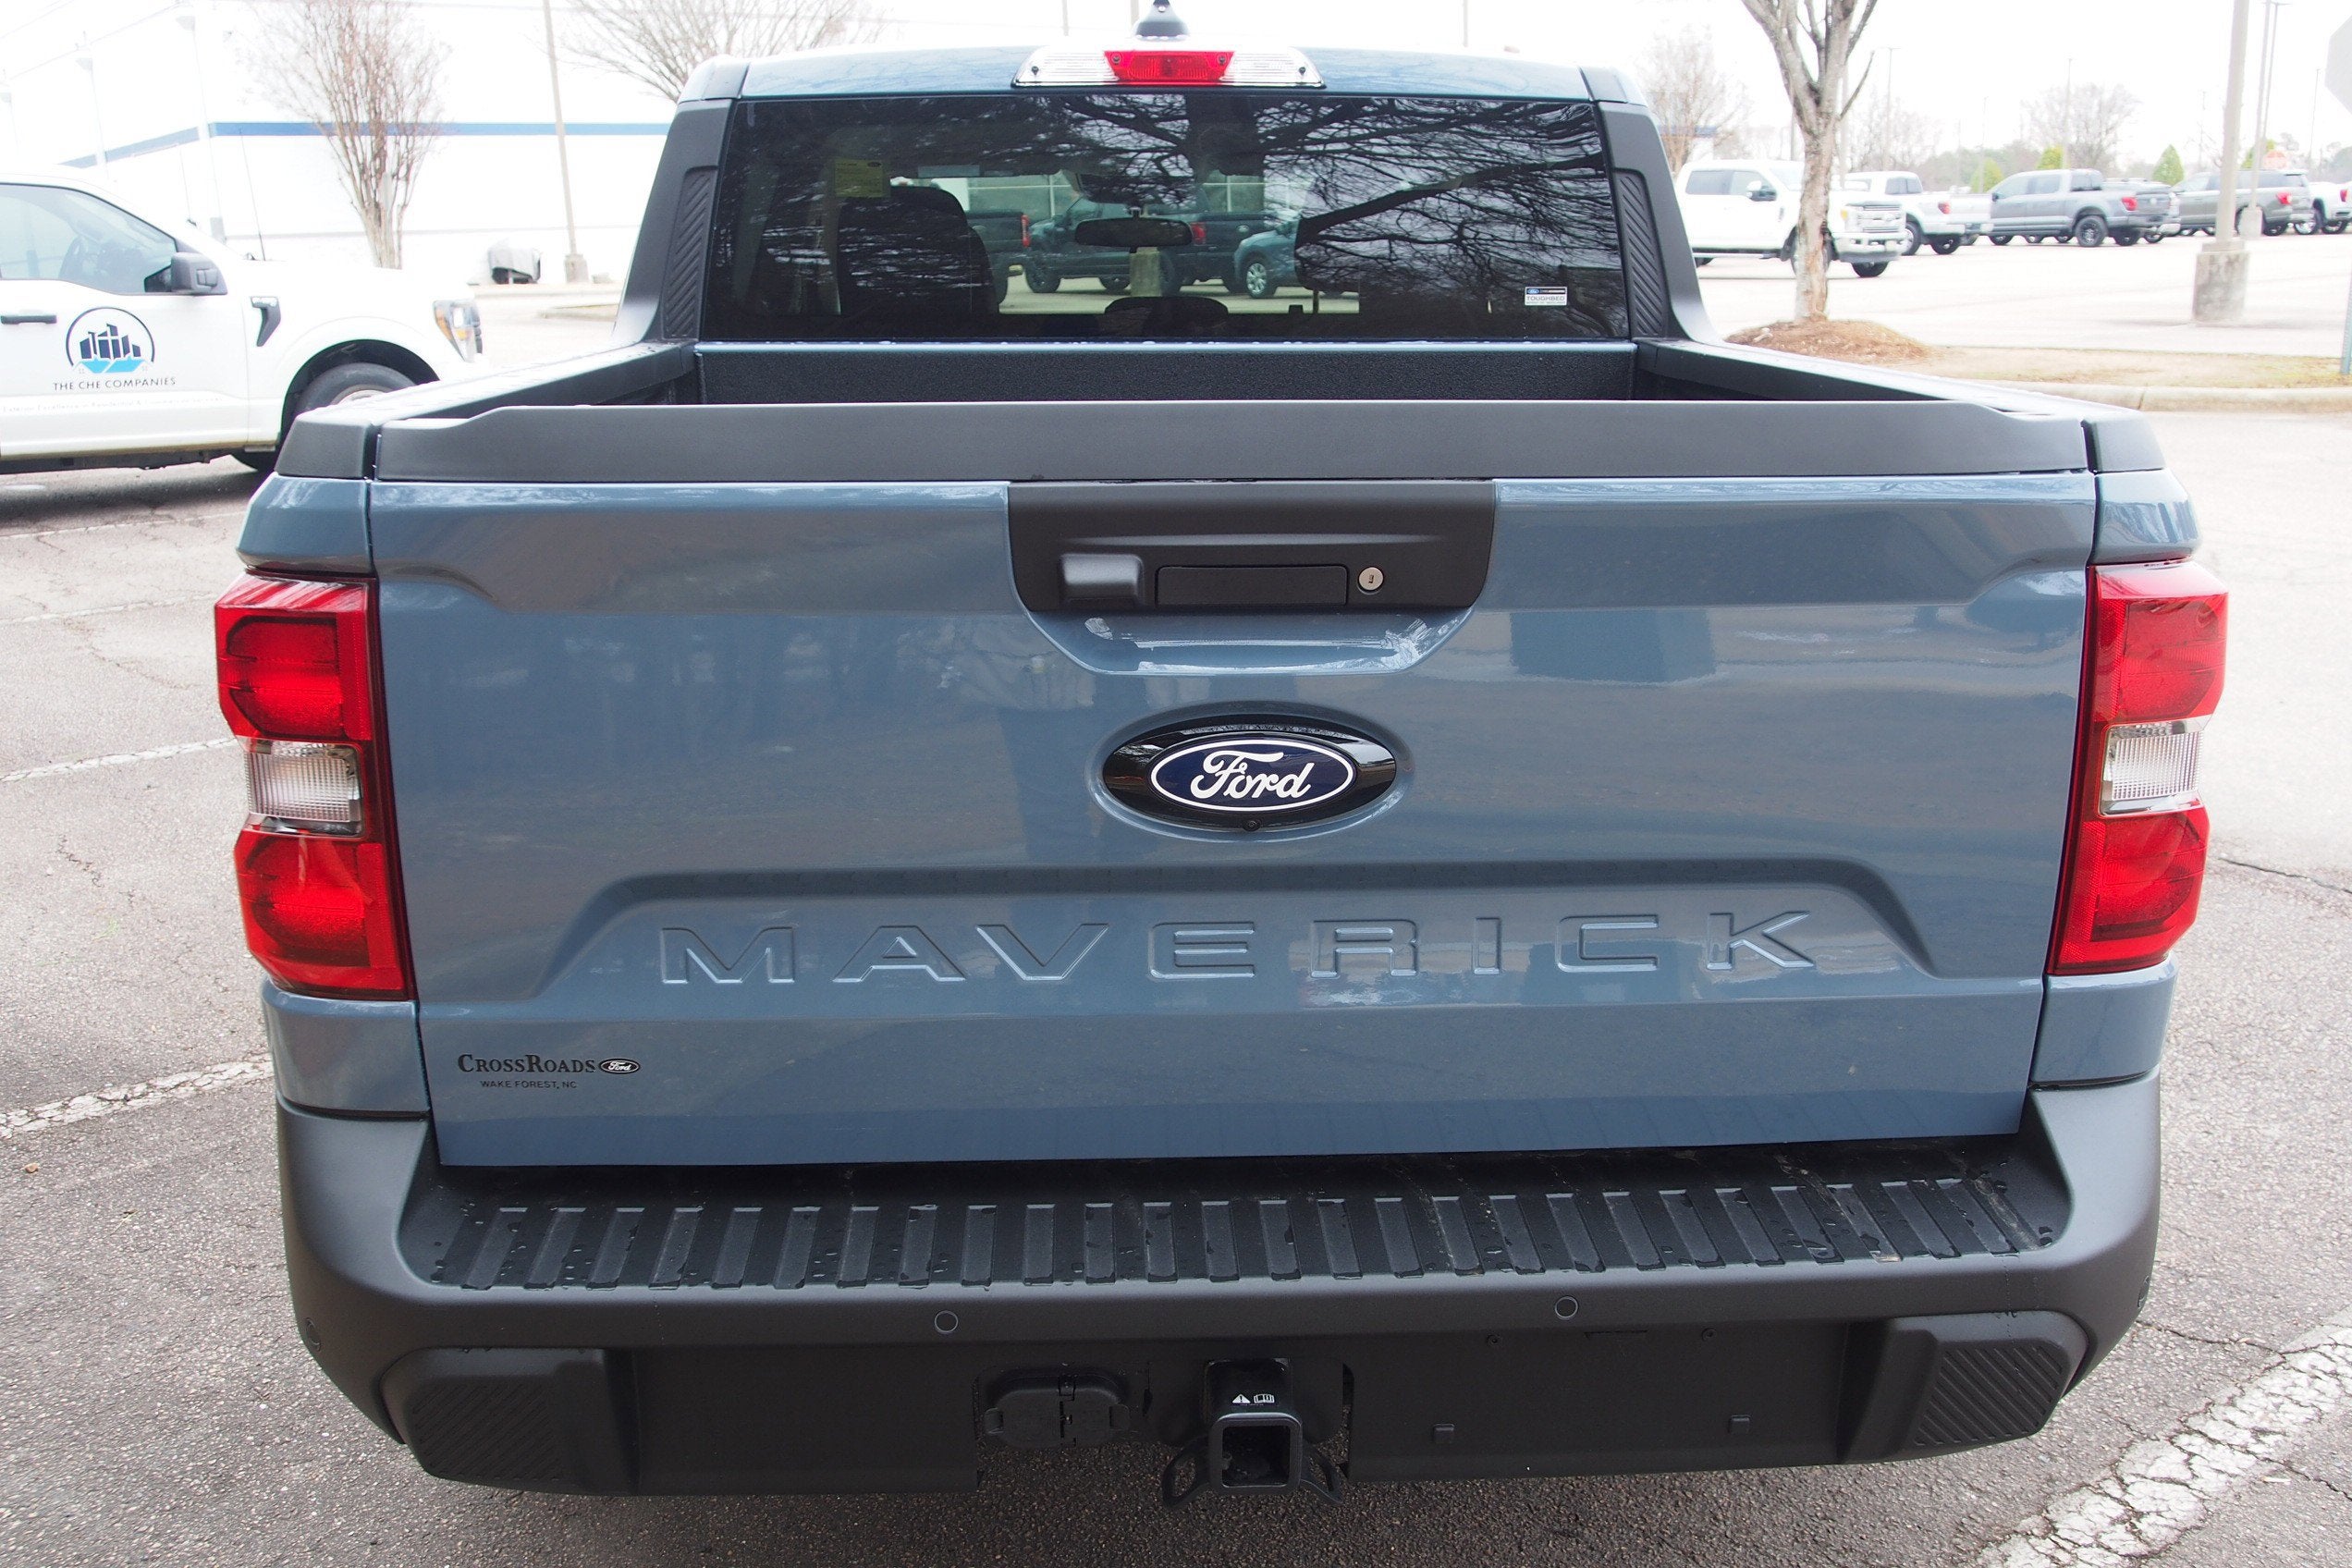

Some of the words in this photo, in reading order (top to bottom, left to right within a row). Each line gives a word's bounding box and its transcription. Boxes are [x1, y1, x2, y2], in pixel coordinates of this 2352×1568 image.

[53, 382, 74, 390] THE
[79, 381, 100, 389] CHE
[104, 376, 176, 388] COMPANIES
[1190, 750, 1315, 799] Ford
[660, 911, 1815, 984] MAVERICK
[606, 1060, 631, 1072] Ford
[480, 1080, 511, 1089] WAKE
[515, 1080, 559, 1090] FOREST,
[562, 1080, 577, 1089] NC
